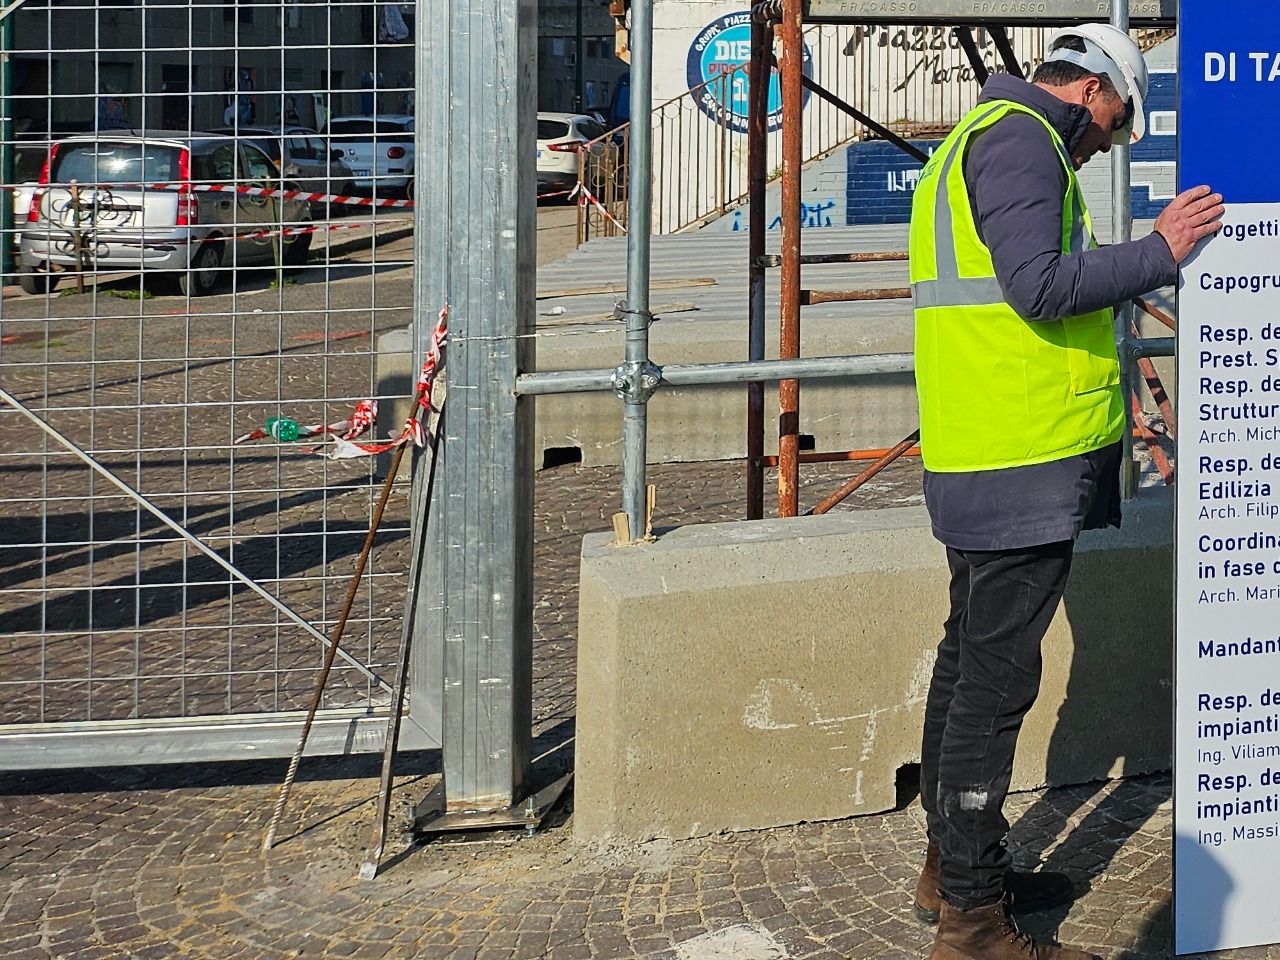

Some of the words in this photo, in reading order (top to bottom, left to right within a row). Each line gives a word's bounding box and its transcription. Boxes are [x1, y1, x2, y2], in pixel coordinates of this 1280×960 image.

[840, 2, 918, 12] FRACASSO
[973, 2, 1046, 13] FRACASSO
[1204, 52, 1236, 82] DI
[1200, 324, 1253, 346] Resp.
[1200, 350, 1258, 369] Prest.
[1198, 428, 1240, 444] Arch.
[1199, 480, 1271, 500] Edilizia
[1198, 561, 1216, 579] in
[1223, 559, 1266, 578] fase
[1198, 715, 1278, 741] impianti
[1197, 795, 1278, 821] impianti
[1197, 828, 1227, 847] Ing.
